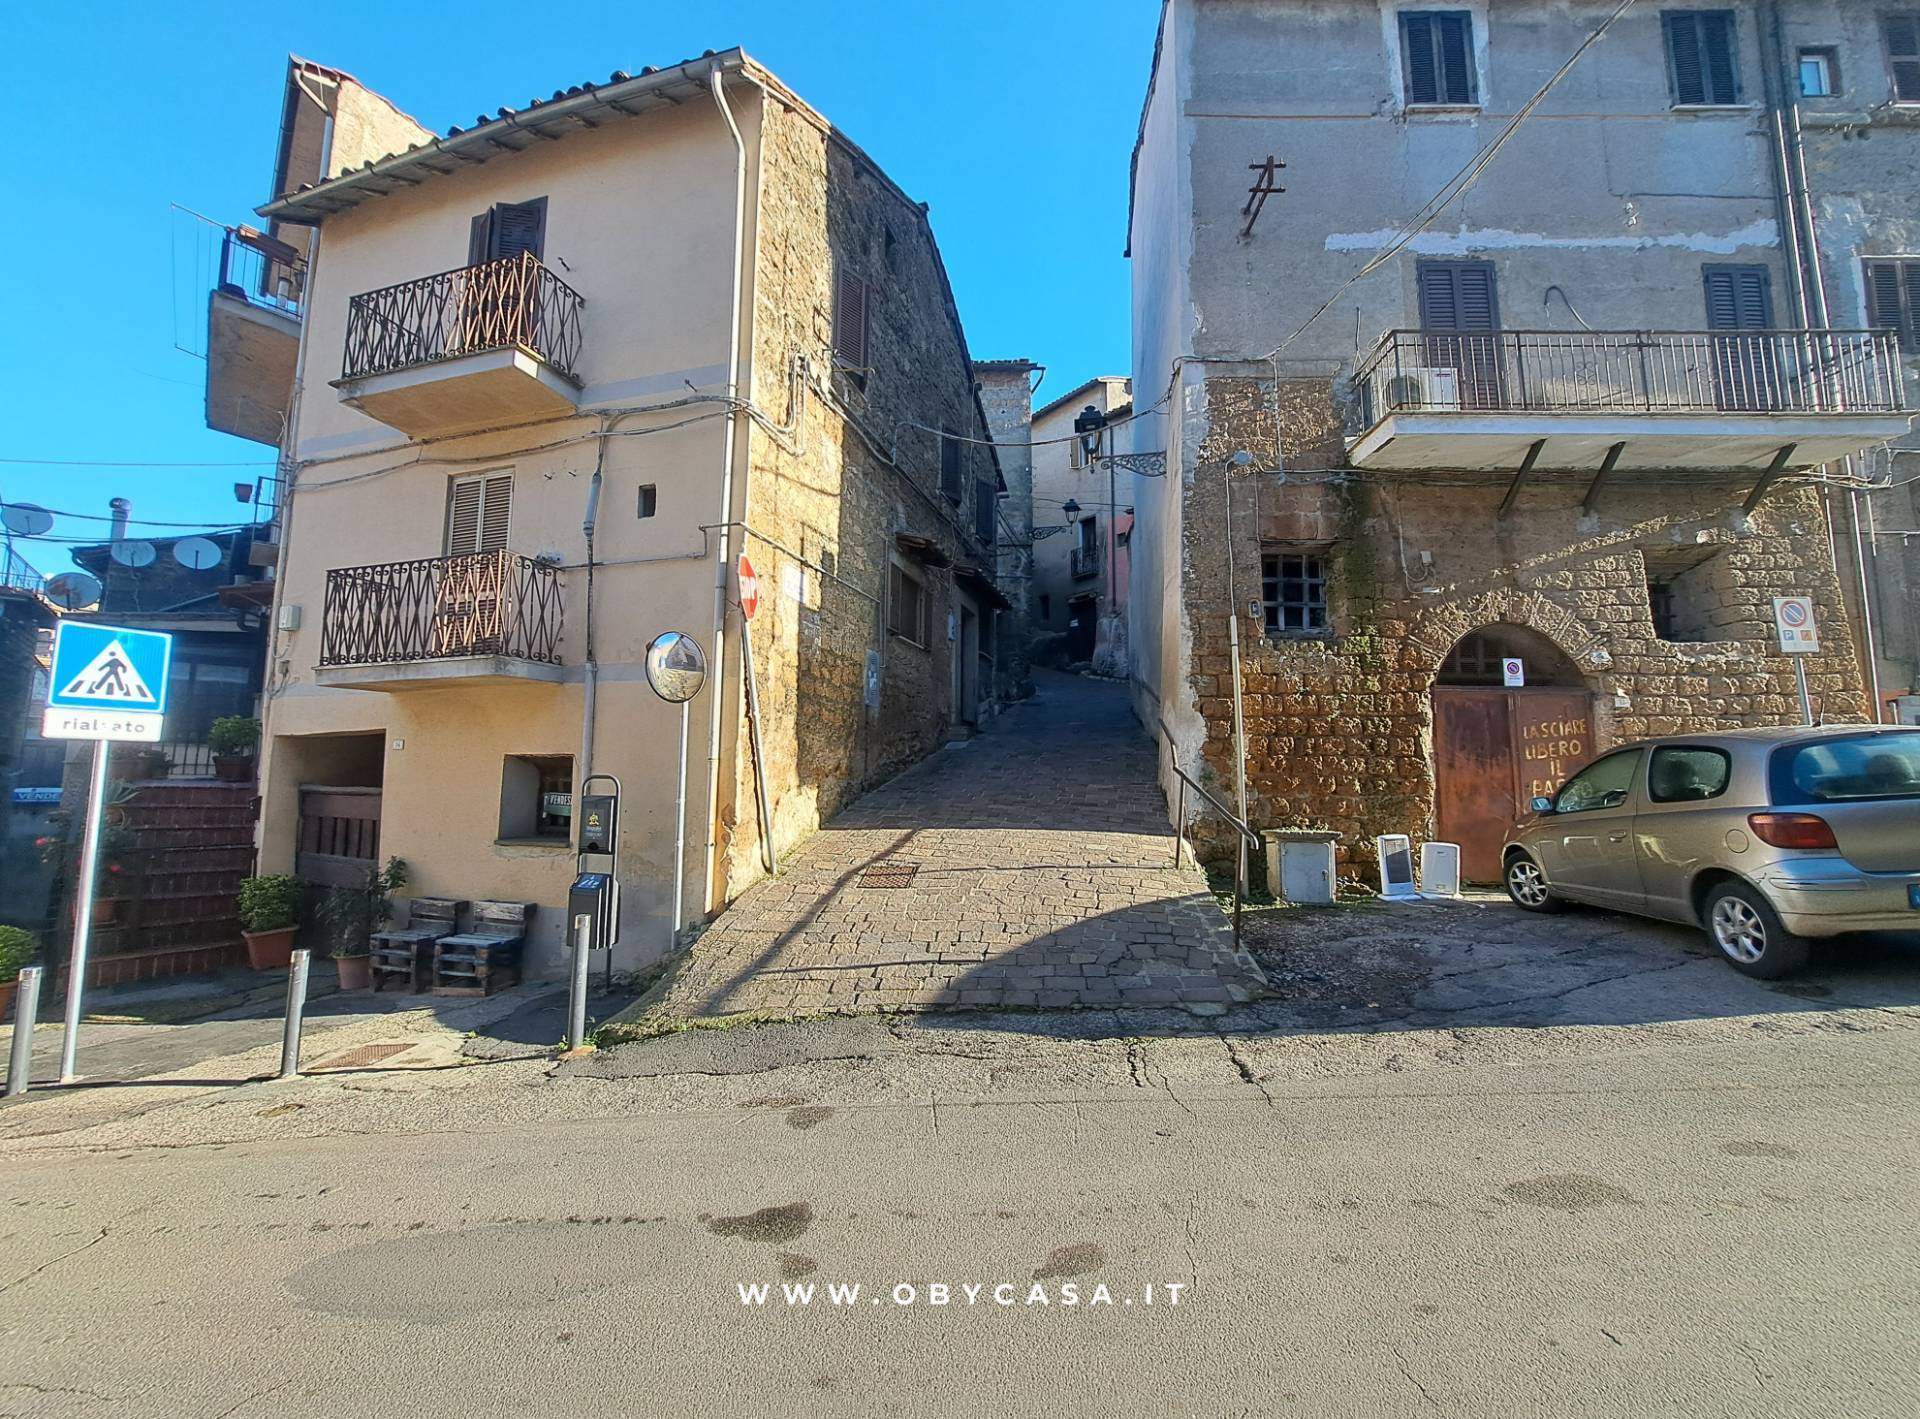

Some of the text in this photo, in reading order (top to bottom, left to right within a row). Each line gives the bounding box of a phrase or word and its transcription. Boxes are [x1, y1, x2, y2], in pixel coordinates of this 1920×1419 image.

[63, 719, 145, 733] rialato
[1525, 740, 1582, 760] LIBERO
[1550, 758, 1567, 776] IL
